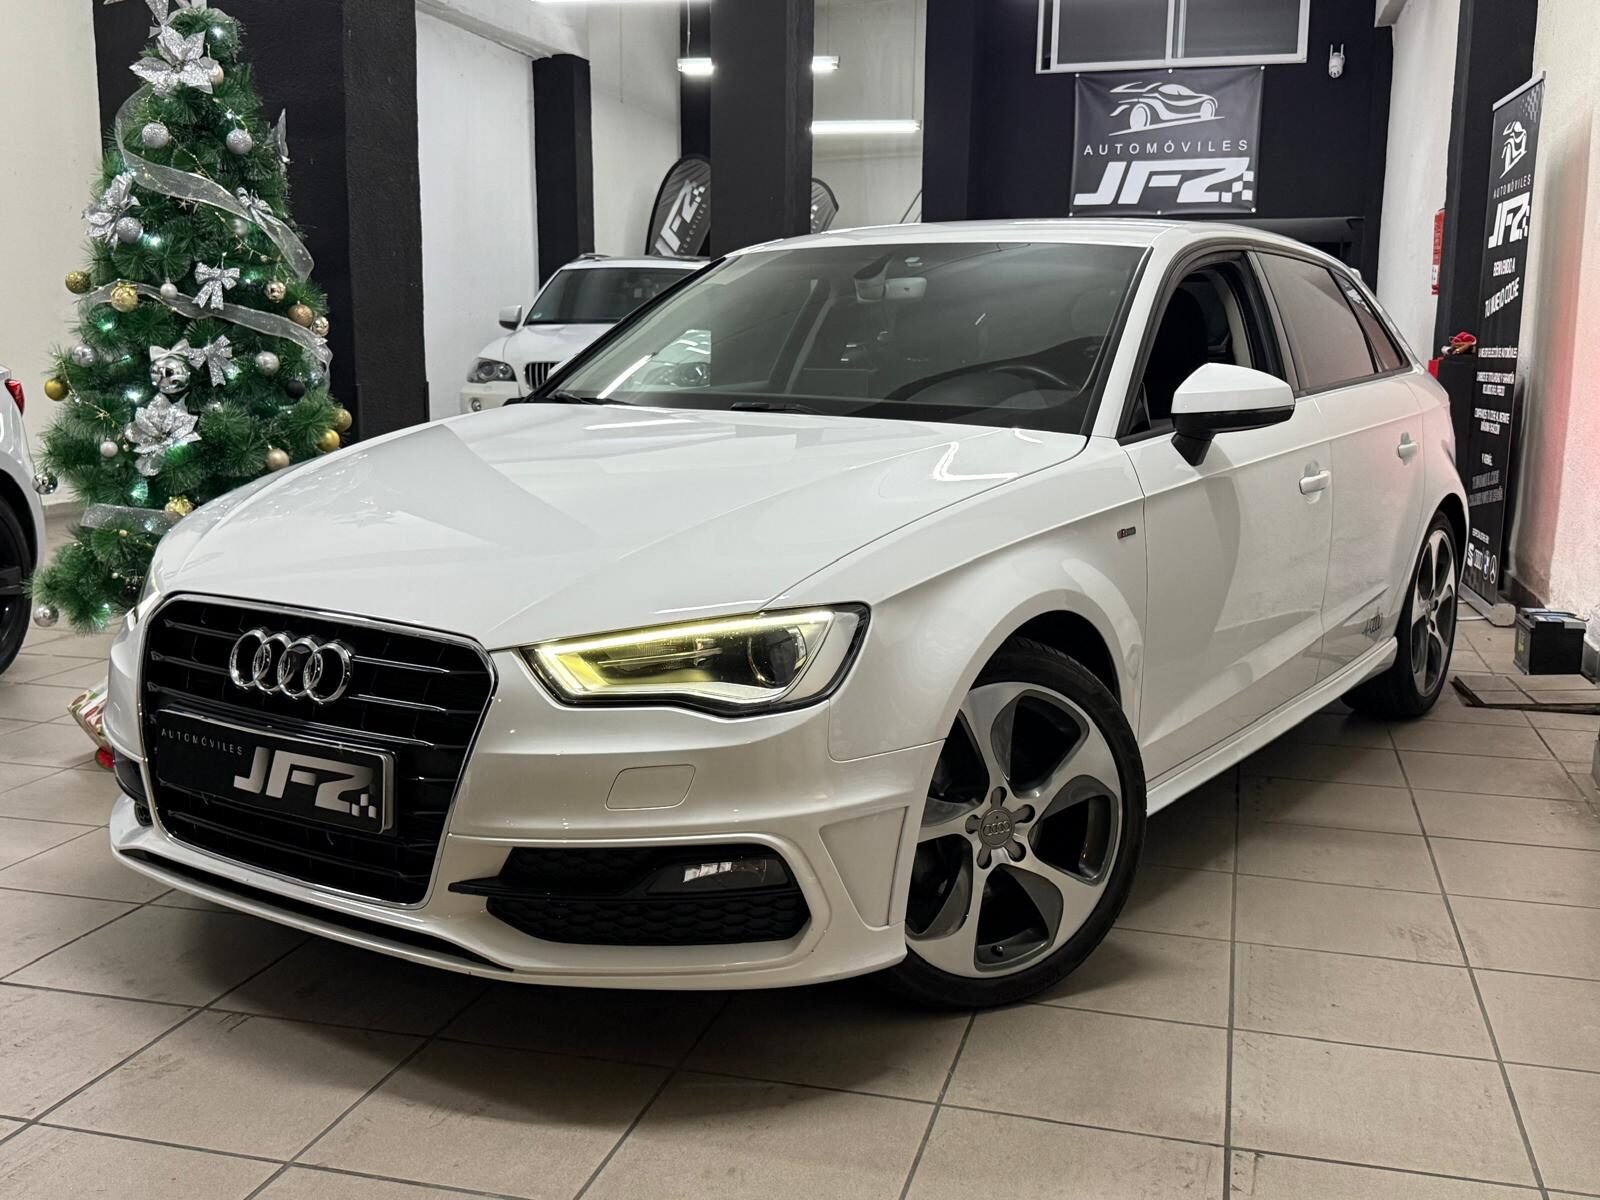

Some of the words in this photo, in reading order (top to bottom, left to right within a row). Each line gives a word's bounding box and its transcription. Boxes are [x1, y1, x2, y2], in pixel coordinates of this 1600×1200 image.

[1083, 139, 1248, 155] AUTOMÓVILES
[1073, 157, 1252, 205] JFZ
[1488, 192, 1530, 249] JFZ
[161, 728, 243, 755] AUTOMÓVILES
[233, 746, 376, 816] JFZ
